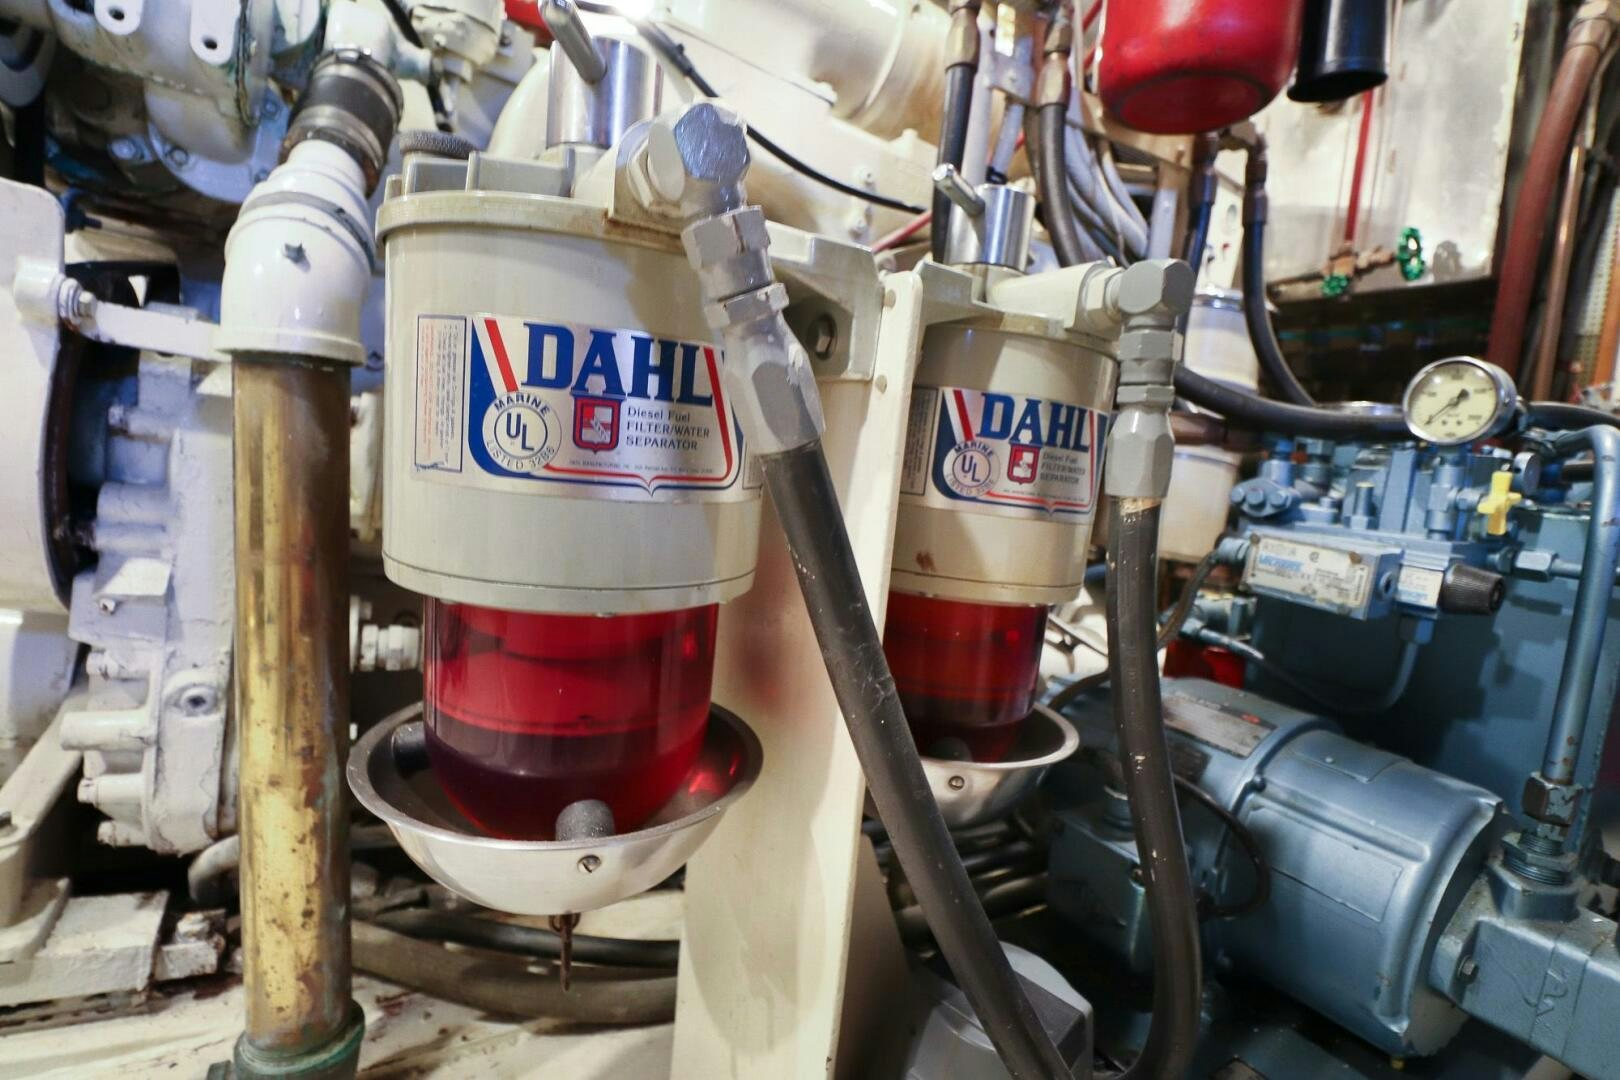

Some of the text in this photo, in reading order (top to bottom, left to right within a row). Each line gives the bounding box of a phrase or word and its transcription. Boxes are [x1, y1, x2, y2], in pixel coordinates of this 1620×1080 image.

[521, 322, 713, 407] DAHL
[494, 392, 550, 417] MARINE
[627, 406, 691, 423] Diesel Fuel
[506, 412, 535, 451] UL
[627, 421, 710, 438] FILTER/WATER
[976, 392, 1090, 453] DAHL
[486, 441, 524, 470] LISTED
[626, 435, 698, 450] SEPARATOR
[954, 441, 993, 457] MARINE
[961, 454, 981, 483] UL
